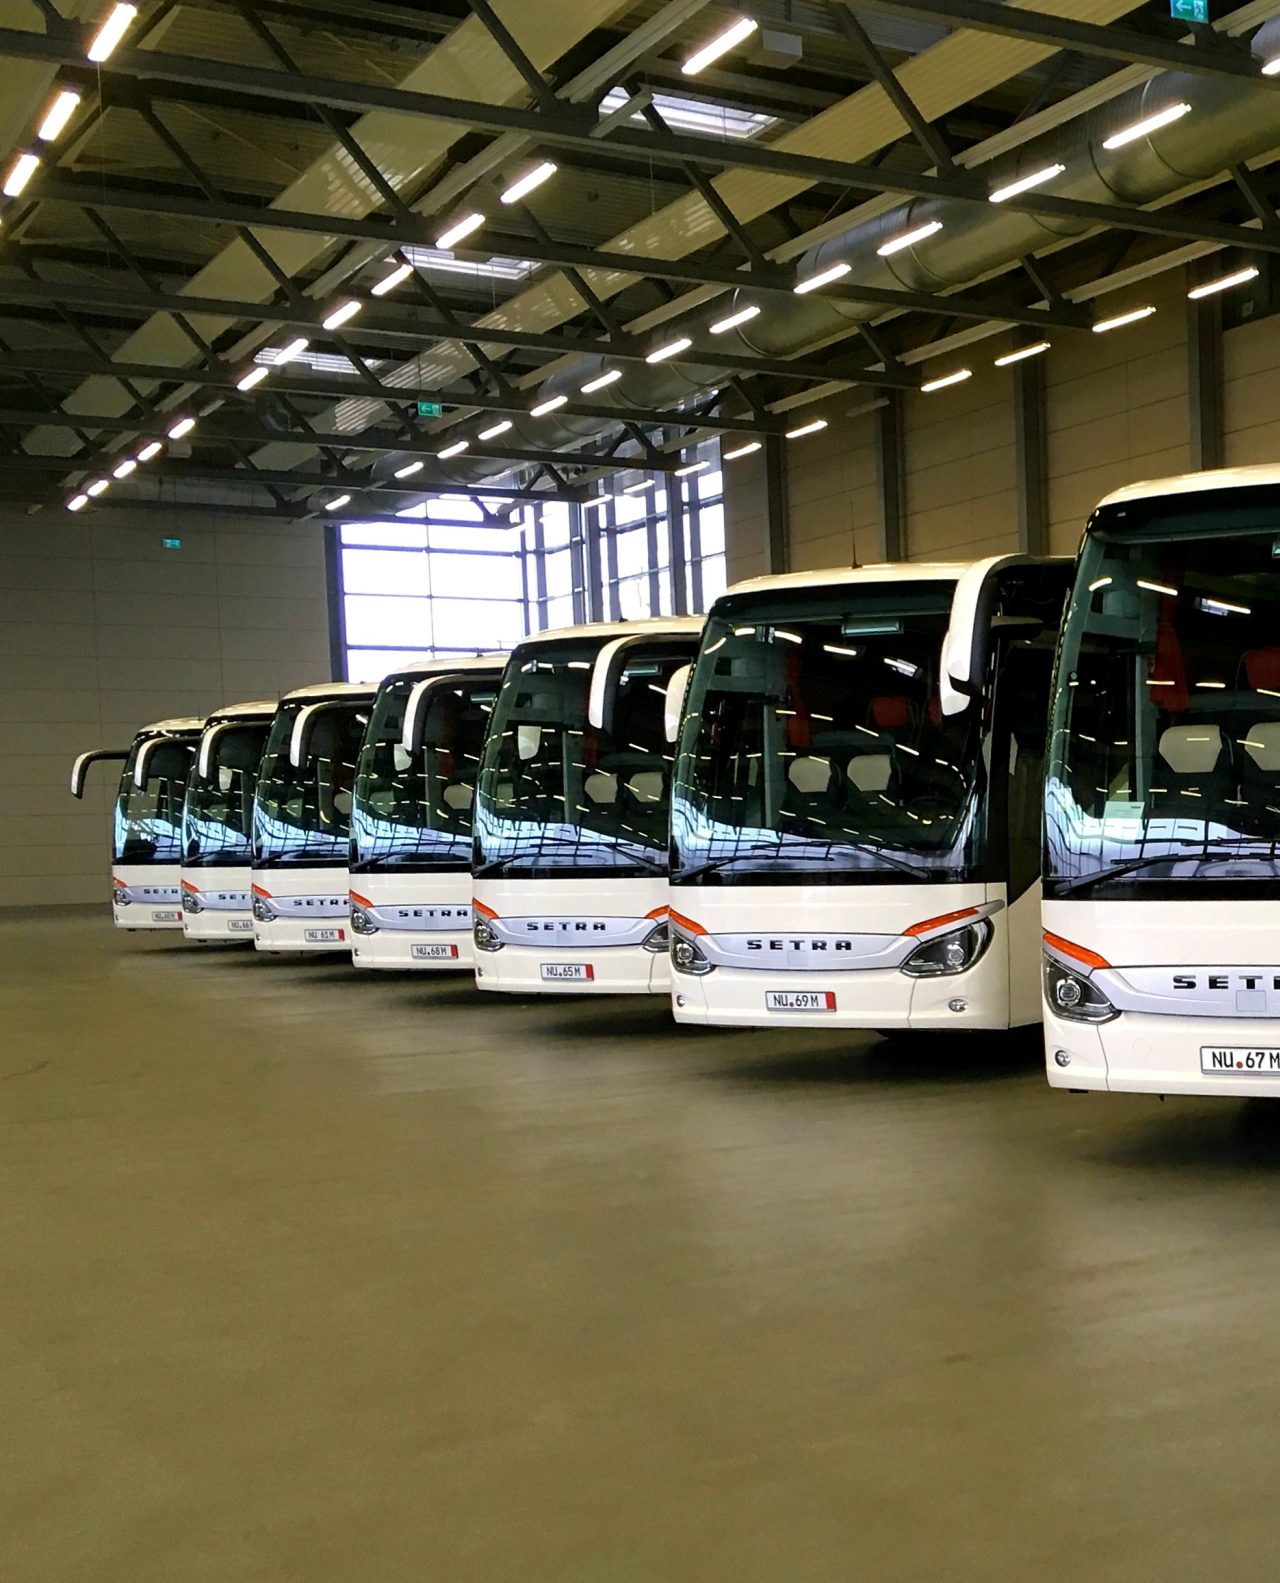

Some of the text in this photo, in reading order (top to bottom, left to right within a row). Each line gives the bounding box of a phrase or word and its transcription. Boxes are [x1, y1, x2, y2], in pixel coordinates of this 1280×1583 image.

[398, 909, 468, 917] SETRA
[526, 921, 606, 931] SETRA
[747, 939, 852, 950] SETRA
